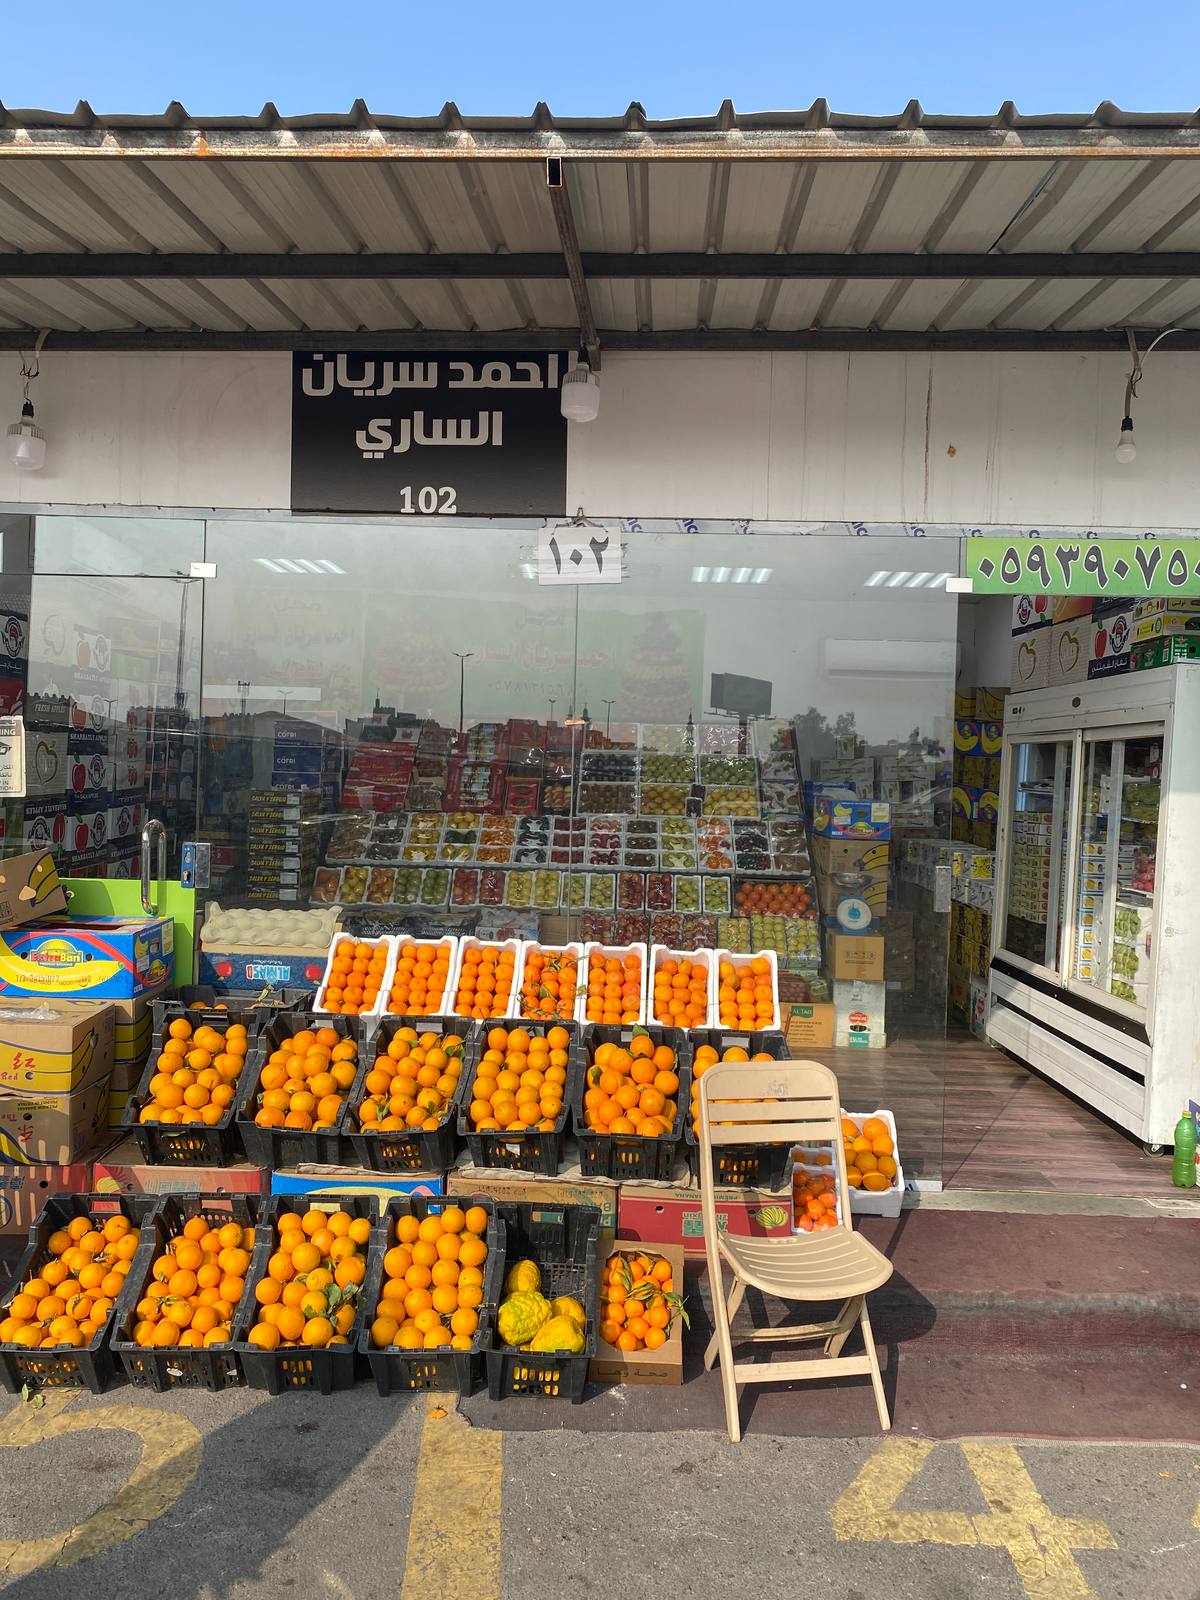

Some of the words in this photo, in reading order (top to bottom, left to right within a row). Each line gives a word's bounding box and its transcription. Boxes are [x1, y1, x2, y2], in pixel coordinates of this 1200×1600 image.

[302, 353, 438, 397] سريان
[448, 354, 558, 389] احمد
[355, 411, 503, 459] الساري
[400, 486, 457, 514] 102
[549, 536, 609, 575] ١٠٢
